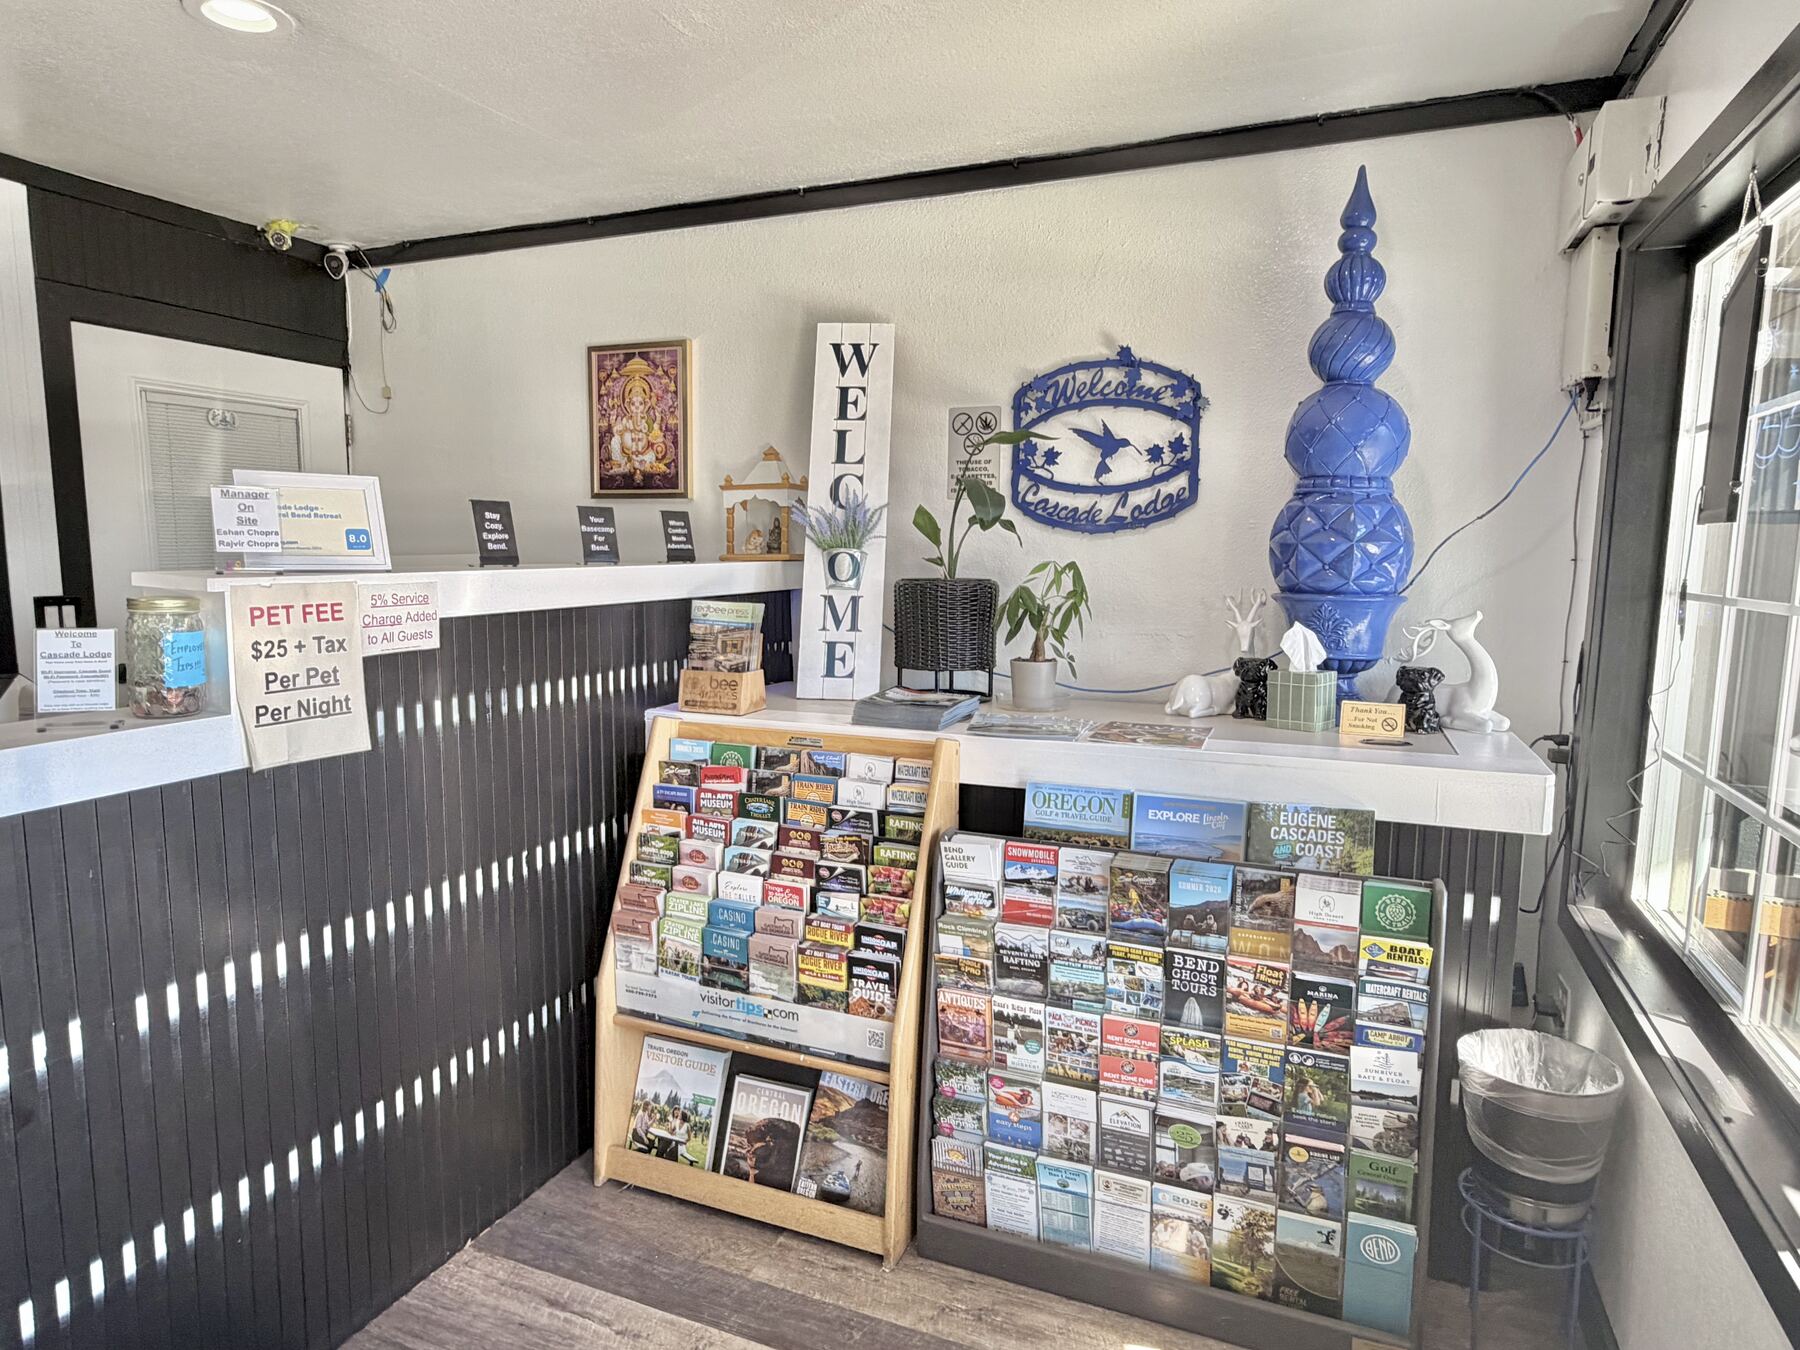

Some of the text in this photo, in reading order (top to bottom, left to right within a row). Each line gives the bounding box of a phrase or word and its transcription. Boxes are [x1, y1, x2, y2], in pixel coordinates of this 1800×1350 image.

[1046, 368, 1168, 407] Welcome
[220, 489, 270, 500] Manager
[237, 503, 255, 513] On
[293, 504, 319, 513] Lodge
[1020, 483, 1187, 526] Cascade Lodge
[236, 516, 258, 527] Site
[484, 511, 500, 521] Stay
[589, 515, 605, 524] Your
[484, 521, 504, 531] Cozy.
[581, 525, 615, 535] Basecamp
[216, 528, 280, 538] Eshan Chopra
[349, 534, 367, 544] 8.0
[482, 532, 509, 542] Explore
[593, 534, 605, 543] For
[218, 539, 245, 550] Rajvir
[247, 540, 280, 549] Chopra
[487, 542, 508, 551] Bend.
[591, 543, 610, 552] Bend.
[370, 592, 430, 607] 5% Service
[249, 602, 345, 627] PET FEE
[362, 610, 438, 627] Charge Added
[54, 629, 98, 638] Welcome
[367, 628, 434, 646] to All Guests
[70, 640, 82, 649] To
[251, 635, 348, 662] $25 + Tax
[40, 650, 113, 660] Cascade Lodge
[265, 665, 340, 692] Per Pet
[709, 674, 738, 691] bee
[255, 694, 353, 725] Per Night
[1350, 706, 1373, 715] Thank
[1348, 722, 1376, 731] Smoking
[897, 764, 921, 779] WATERCRAFT
[816, 782, 833, 792] RIDES
[700, 791, 734, 801] AIR AUTO
[891, 790, 915, 803] WATERCRAFT
[700, 799, 734, 809] MUSEUM
[810, 804, 827, 813] RIDES
[1032, 790, 1118, 816] OREGON
[692, 818, 704, 827] AIR
[1035, 810, 1113, 824] GOLF TRAVEL GUIDE
[1148, 809, 1201, 824] EXPLORE
[1203, 811, 1229, 825] Lincoln
[1280, 811, 1337, 830] EUGENE
[889, 818, 924, 831] RAFTING
[691, 826, 726, 839] MUSEUM
[1270, 827, 1346, 845] CASCADES
[880, 848, 917, 861] RAFTING
[943, 846, 964, 854] BEND
[1007, 846, 1055, 861] SNOWMOBILE
[1272, 842, 1344, 860] AND COAST
[944, 854, 976, 863] GALLERY
[945, 862, 969, 870] GUIDE
[764, 883, 784, 893] Things
[767, 896, 800, 907] OREGON
[668, 903, 705, 916] ZIPLINE
[718, 908, 747, 925] CASINO
[663, 926, 700, 941] ZIPLINE
[807, 925, 849, 943] ROGUE RIVER
[938, 922, 988, 936] Rock Climbing
[712, 933, 740, 950] CASINO
[1389, 944, 1421, 956] BOAT
[800, 954, 843, 972] ROGUE RIVER
[1002, 955, 1041, 968] RAFTING
[1173, 954, 1220, 973] BEND
[1386, 952, 1425, 965] RENTALS
[1171, 969, 1218, 986] GHOST
[1256, 964, 1285, 979] Float
[852, 978, 892, 993] TRAVEL
[1171, 979, 1218, 997] TOURS
[852, 988, 892, 1003] GUIDE
[1306, 989, 1339, 1000] MARINA
[1365, 983, 1428, 1003] WATERCRAFT RENTALS
[938, 990, 986, 1010] ANTIQUES
[1106, 1034, 1141, 1046] RENT SOME
[1370, 1030, 1388, 1039] CAMP
[1169, 1036, 1210, 1049] SPLASH
[647, 1044, 688, 1058] TRAVEL OREGON
[646, 1051, 717, 1074] VISITOR GUIDE
[1103, 1071, 1138, 1083] RENT SOME
[1357, 1073, 1410, 1085] RAFT FLOAT
[1364, 1068, 1403, 1077] SUNRIVER
[824, 1071, 869, 1097] EASTERN
[942, 1079, 981, 1093] planner
[756, 1087, 785, 1100] CENTRAL
[737, 1092, 802, 1118] OREGON
[940, 1116, 978, 1130] planner
[995, 1119, 1033, 1132] easy steps
[1109, 1117, 1142, 1130] ELEVATION
[1368, 1161, 1399, 1176] Golf
[1172, 1194, 1208, 1210] 2026
[1366, 1236, 1395, 1262] BEND
